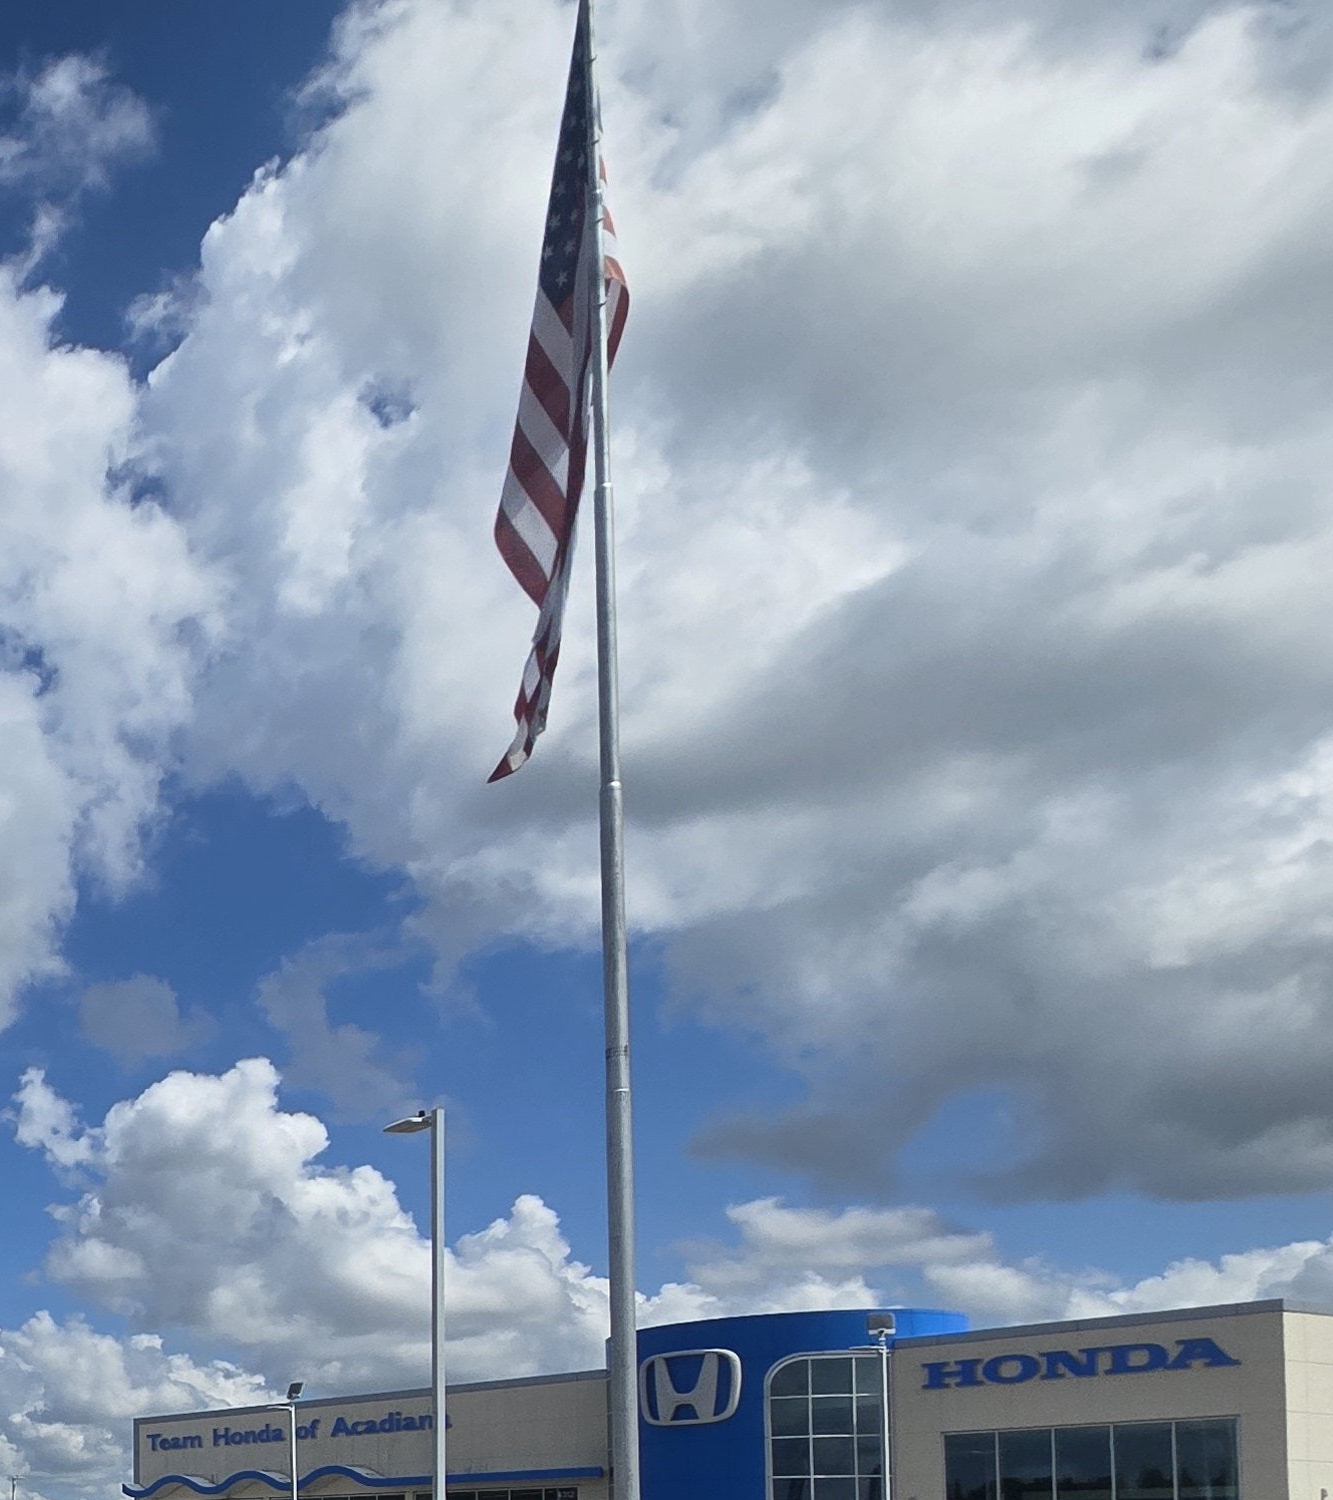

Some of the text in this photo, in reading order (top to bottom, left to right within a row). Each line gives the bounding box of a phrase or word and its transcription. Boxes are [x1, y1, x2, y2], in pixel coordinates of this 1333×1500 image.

[920, 1337, 1242, 1390] HONDA
[146, 1433, 204, 1451] Team
[212, 1423, 285, 1447] Honda
[296, 1419, 320, 1440] of
